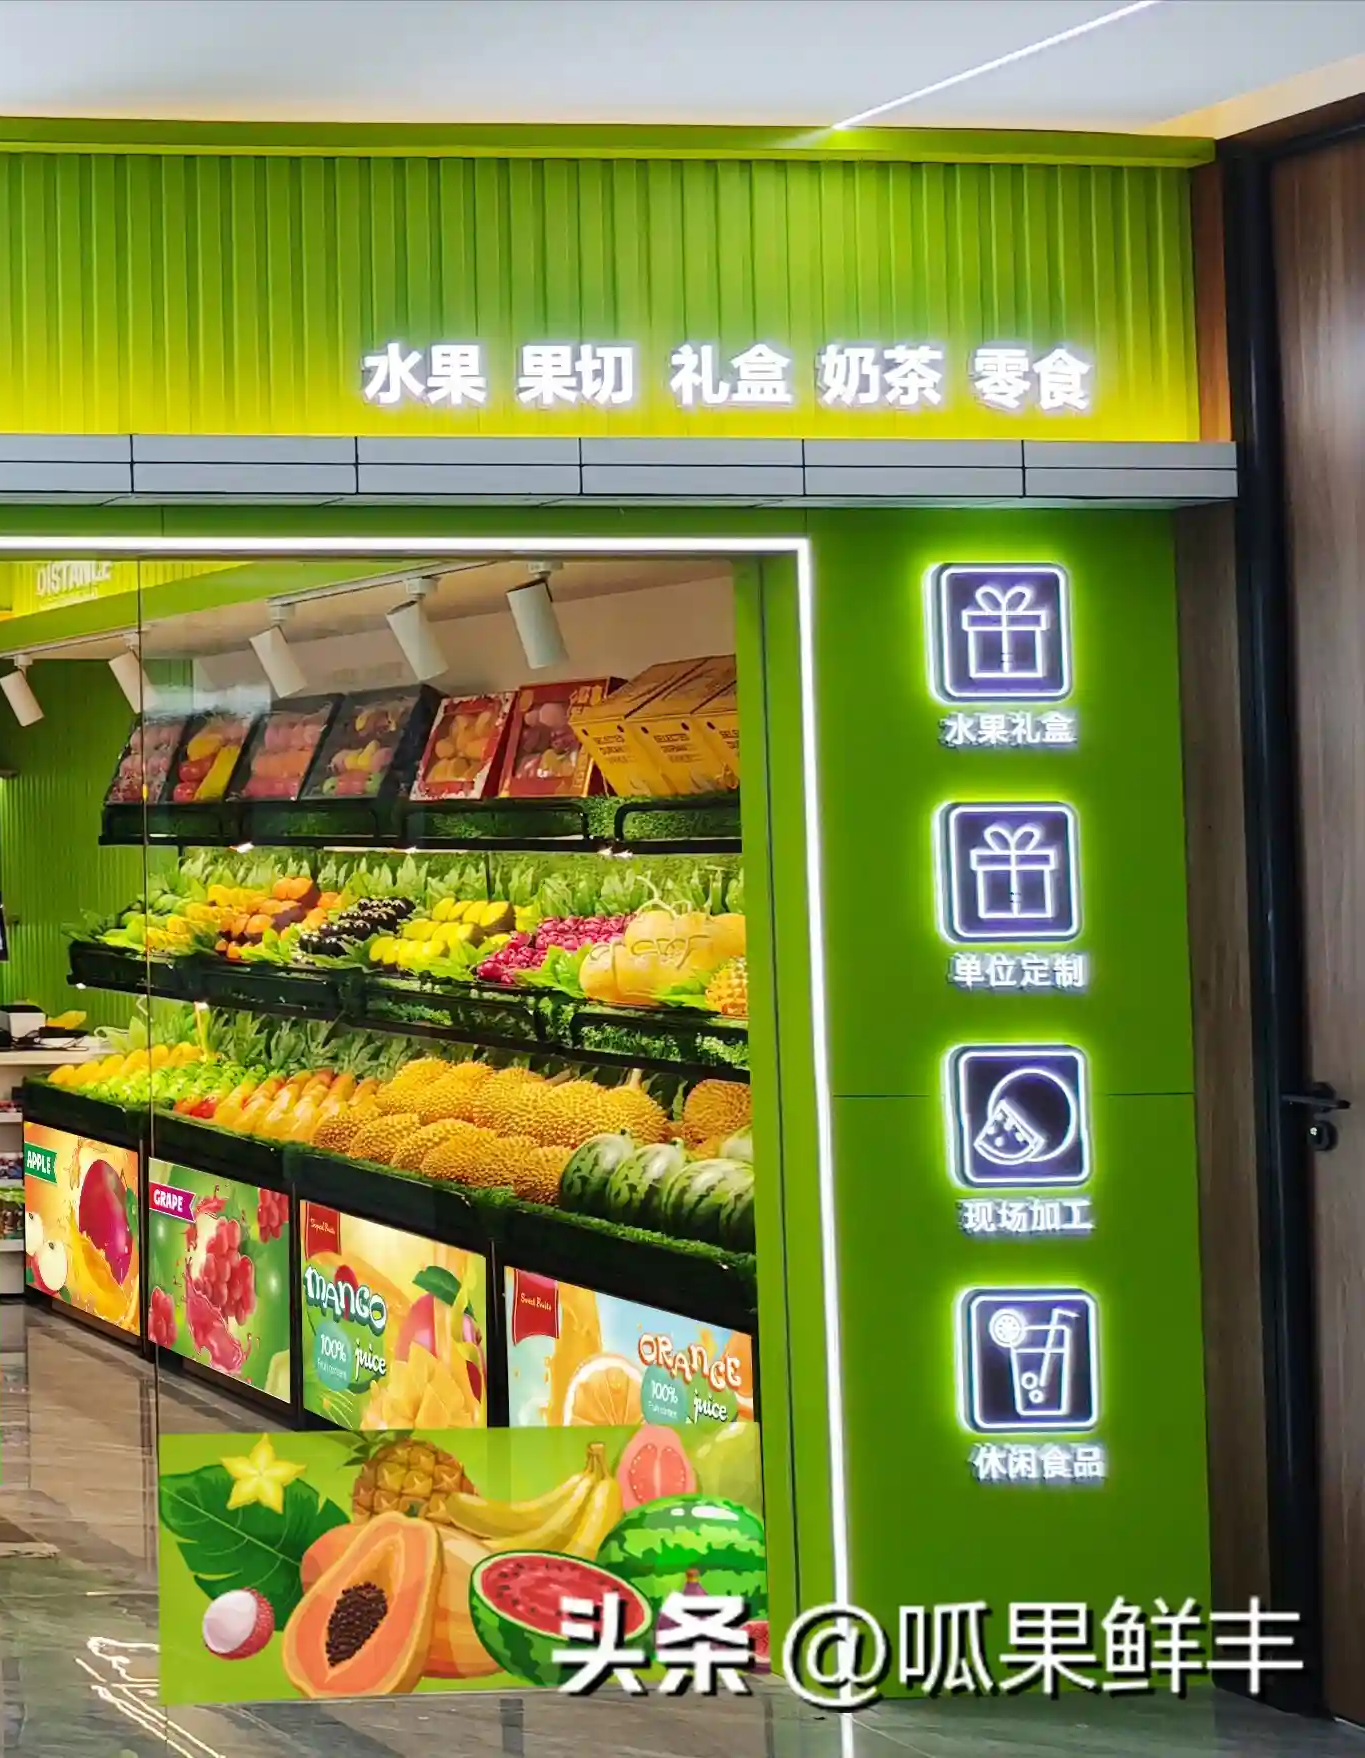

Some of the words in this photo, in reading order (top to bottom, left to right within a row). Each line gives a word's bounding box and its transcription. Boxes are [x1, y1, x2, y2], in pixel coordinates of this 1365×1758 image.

[362, 342, 486, 407] 水果
[518, 343, 635, 407] 果切
[669, 344, 793, 407] 礼盒
[817, 345, 945, 408] 奶茶
[972, 348, 1093, 412] 零食
[942, 712, 1078, 747] 水果礼盒
[951, 952, 1087, 989] 单位定制
[26, 1150, 52, 1175] APPLE
[153, 1188, 184, 1213] GRAPE
[962, 1199, 1095, 1233] 现场加工
[303, 1265, 388, 1336] MANGO
[320, 1333, 347, 1362] 100%
[354, 1338, 388, 1382] juice
[638, 1332, 743, 1392] ORANGE
[651, 1379, 679, 1404] 100%
[693, 1388, 728, 1424] juice
[971, 1444, 1107, 1481] 休闲食品
